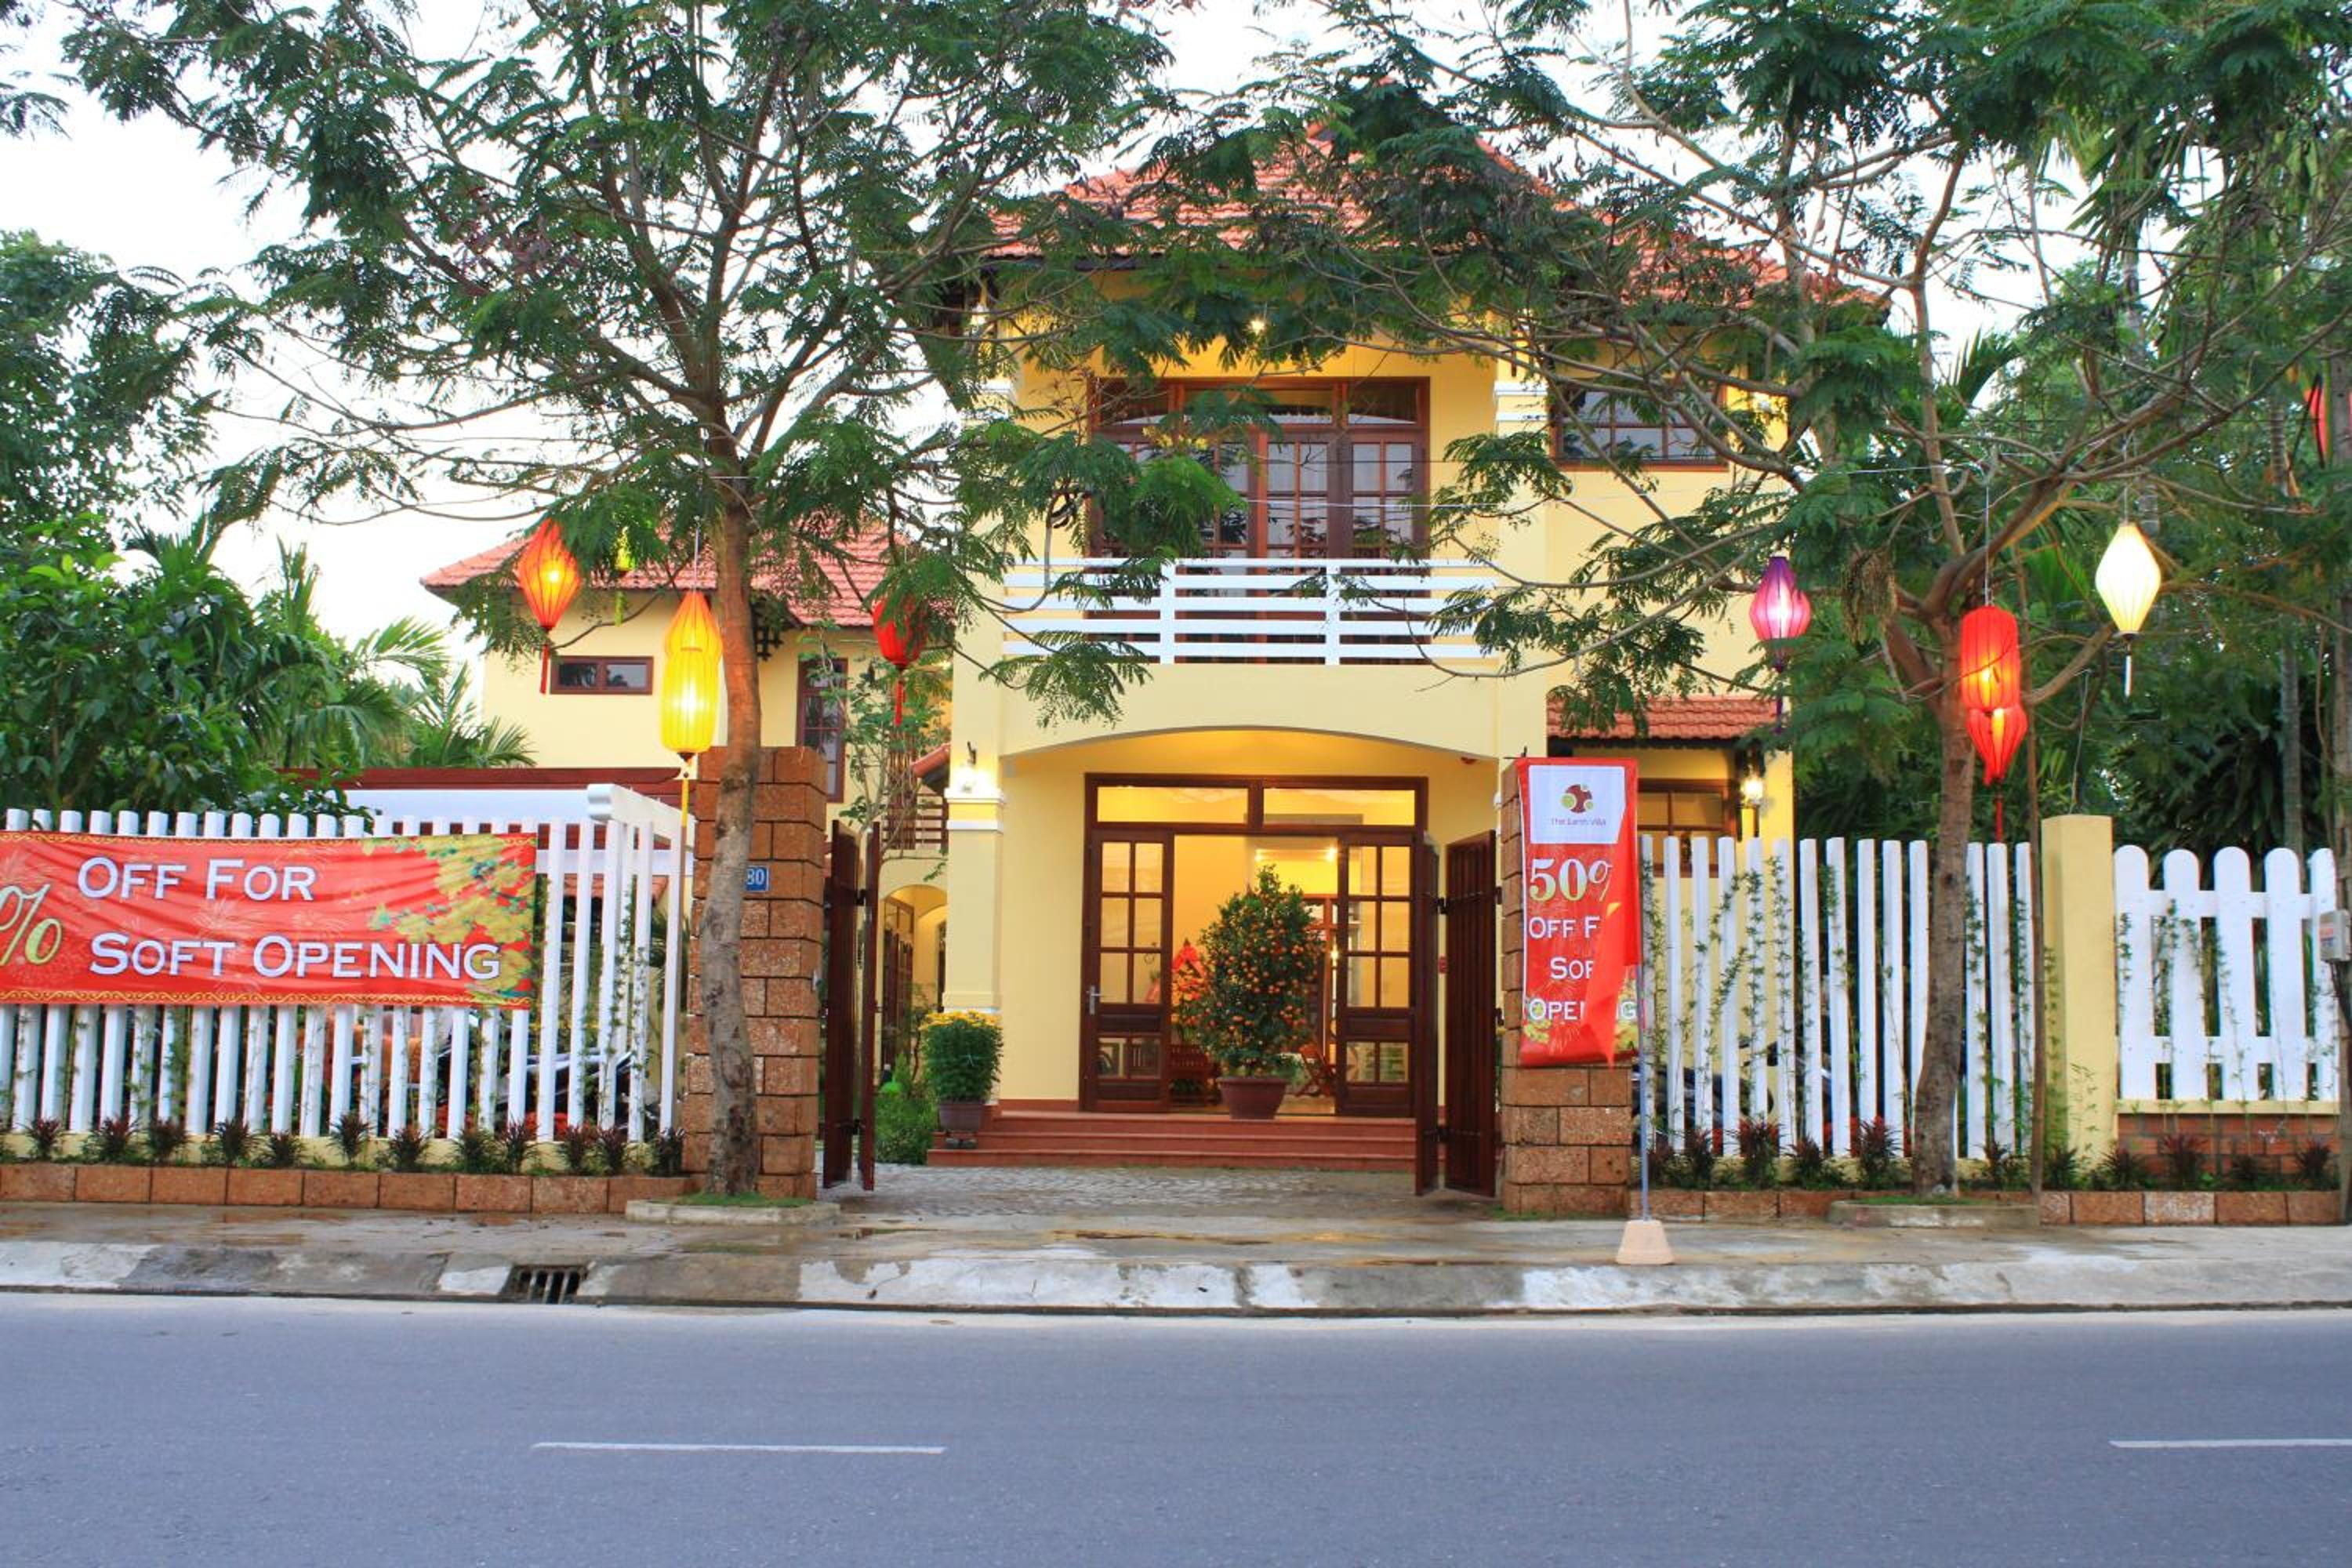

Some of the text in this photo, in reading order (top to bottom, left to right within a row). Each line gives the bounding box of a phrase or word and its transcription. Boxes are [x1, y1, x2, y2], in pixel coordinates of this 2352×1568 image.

[78, 857, 317, 902] OFF FOR
[1528, 916, 1577, 939] OFF
[89, 932, 500, 980] SOFT OPENING
[1550, 956, 1595, 979] SOF
